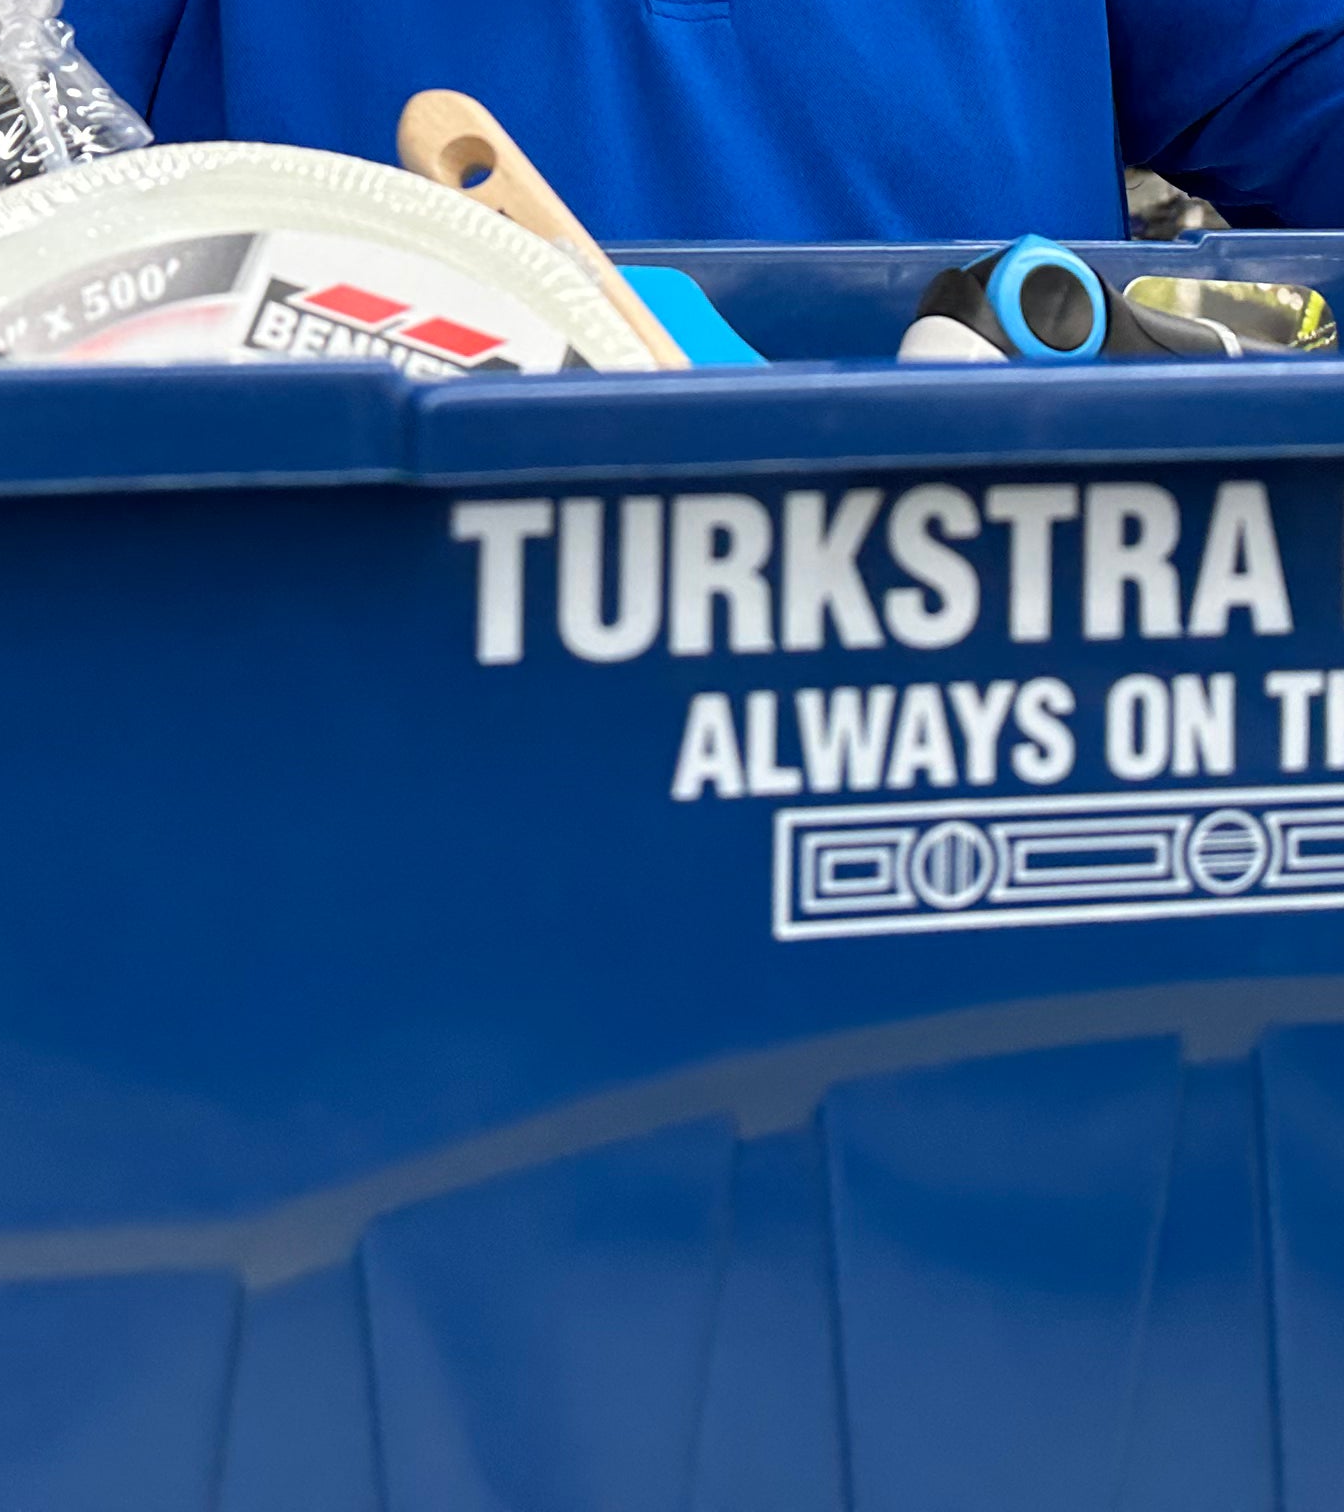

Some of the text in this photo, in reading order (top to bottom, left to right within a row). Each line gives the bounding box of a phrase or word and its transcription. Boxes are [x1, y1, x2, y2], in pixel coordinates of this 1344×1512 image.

[450, 483, 1294, 666] TURKSTRA
[670, 678, 1077, 800] ALWAYS
[1105, 672, 1235, 779] ON
